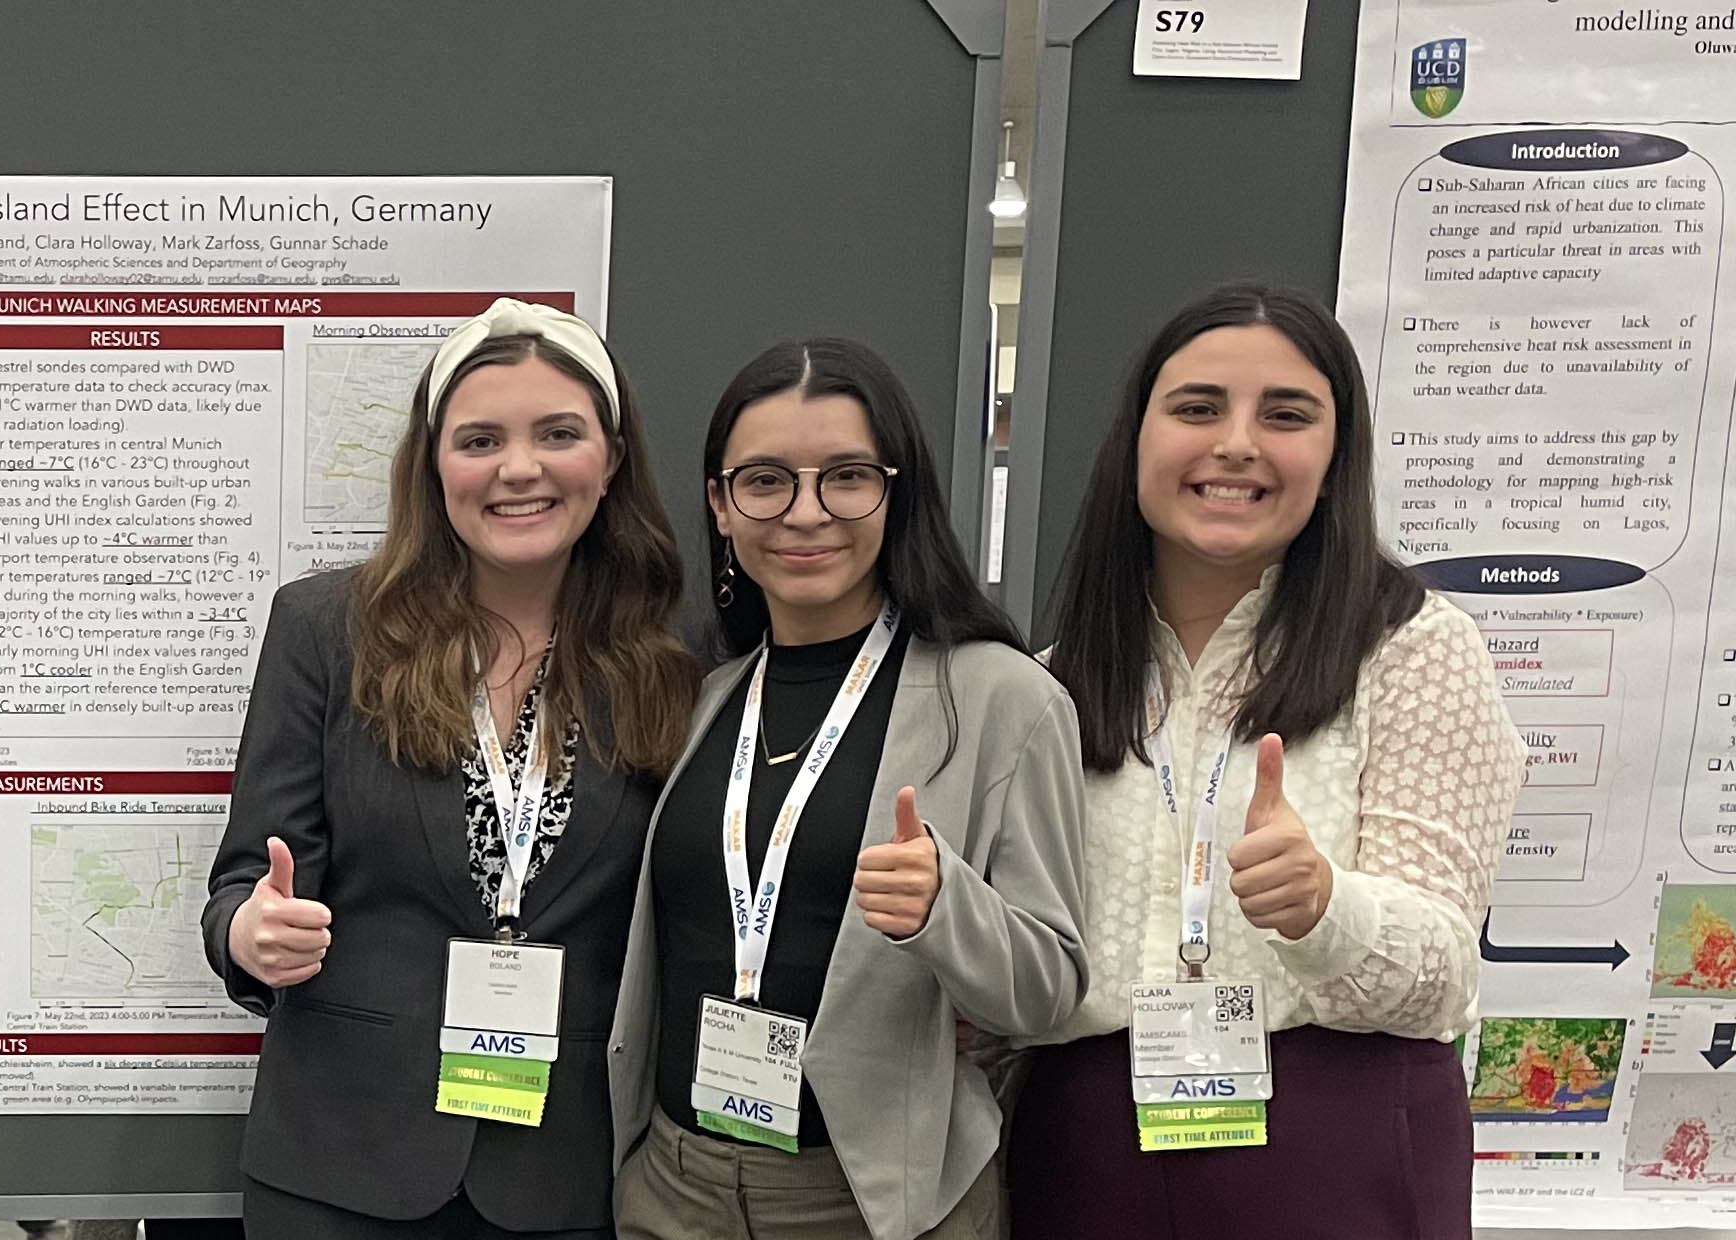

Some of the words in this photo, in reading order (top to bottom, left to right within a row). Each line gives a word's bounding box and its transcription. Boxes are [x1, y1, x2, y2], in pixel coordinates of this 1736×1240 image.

[1156, 11, 1205, 33] S79
[1575, 11, 1688, 36] modelling
[1695, 10, 1734, 30] and
[1417, 61, 1460, 78] UCD
[1511, 142, 1619, 159] Introduction
[1435, 177, 1524, 192] Sub-Saharan
[1532, 175, 1585, 190] African
[1592, 175, 1629, 189] cities
[1636, 179, 1657, 189] are
[1665, 174, 1706, 192] facing
[83, 192, 170, 221] Effect
[181, 195, 204, 221] in
[219, 192, 338, 226] Munich,
[351, 194, 492, 230] Germany
[34, 233, 74, 249] Clara
[80, 234, 156, 252] Holloway,
[162, 234, 200, 250] Mark
[204, 234, 264, 252] Zarfoss,
[269, 235, 327, 250] Gunnar
[331, 234, 388, 250] Schade
[19, 255, 32, 268] of
[34, 255, 109, 271] Atmospheric
[112, 255, 163, 268] Sciences
[166, 255, 188, 268] and
[191, 256, 262, 271] Department
[265, 255, 278, 268] of
[280, 256, 347, 271] Geography
[56, 298, 136, 314] WALKING
[141, 298, 271, 314] MEASUREMENT
[274, 299, 322, 314] MAPS
[90, 330, 160, 347] RESULTS
[313, 324, 364, 338] Morning
[368, 323, 429, 338] Observed
[36, 359, 86, 373] sondes
[89, 359, 160, 376] compared
[164, 359, 192, 373] with
[197, 360, 235, 373] DWD
[1481, 566, 1560, 583] Methods
[1487, 637, 1539, 653] Hazard
[1501, 675, 1574, 691] Simulated
[807, 739, 833, 774] AMS
[1548, 751, 1578, 764] RWI
[1206, 767, 1222, 805] AMS
[37, 801, 87, 814] Inbound
[90, 801, 116, 814] Bike
[120, 800, 146, 814] Ride
[150, 801, 226, 814] Temperature
[519, 795, 535, 832] AMS
[1506, 843, 1558, 856] density
[733, 887, 749, 925] AMS
[754, 897, 772, 936] AMS
[491, 949, 520, 960] HOPE
[489, 961, 522, 972] BOLAND
[1133, 988, 1172, 998] CLARA
[705, 1004, 746, 1022] JULIETTE
[1133, 1001, 1196, 1012] HOLLOWAY
[703, 1018, 736, 1033] ROCHA
[471, 1034, 526, 1055] AMS
[779, 1059, 799, 1071] FULL
[1171, 1078, 1236, 1098] AMS
[447, 1098, 469, 1110] FIRST
[491, 1103, 532, 1120] ATTENDEE
[722, 1095, 773, 1123] AMS
[1147, 1108, 1191, 1121] STUDENT
[1153, 1133, 1181, 1145] FIRST
[1184, 1132, 1207, 1142] TIME
[1209, 1129, 1256, 1141] ATTENDEE
